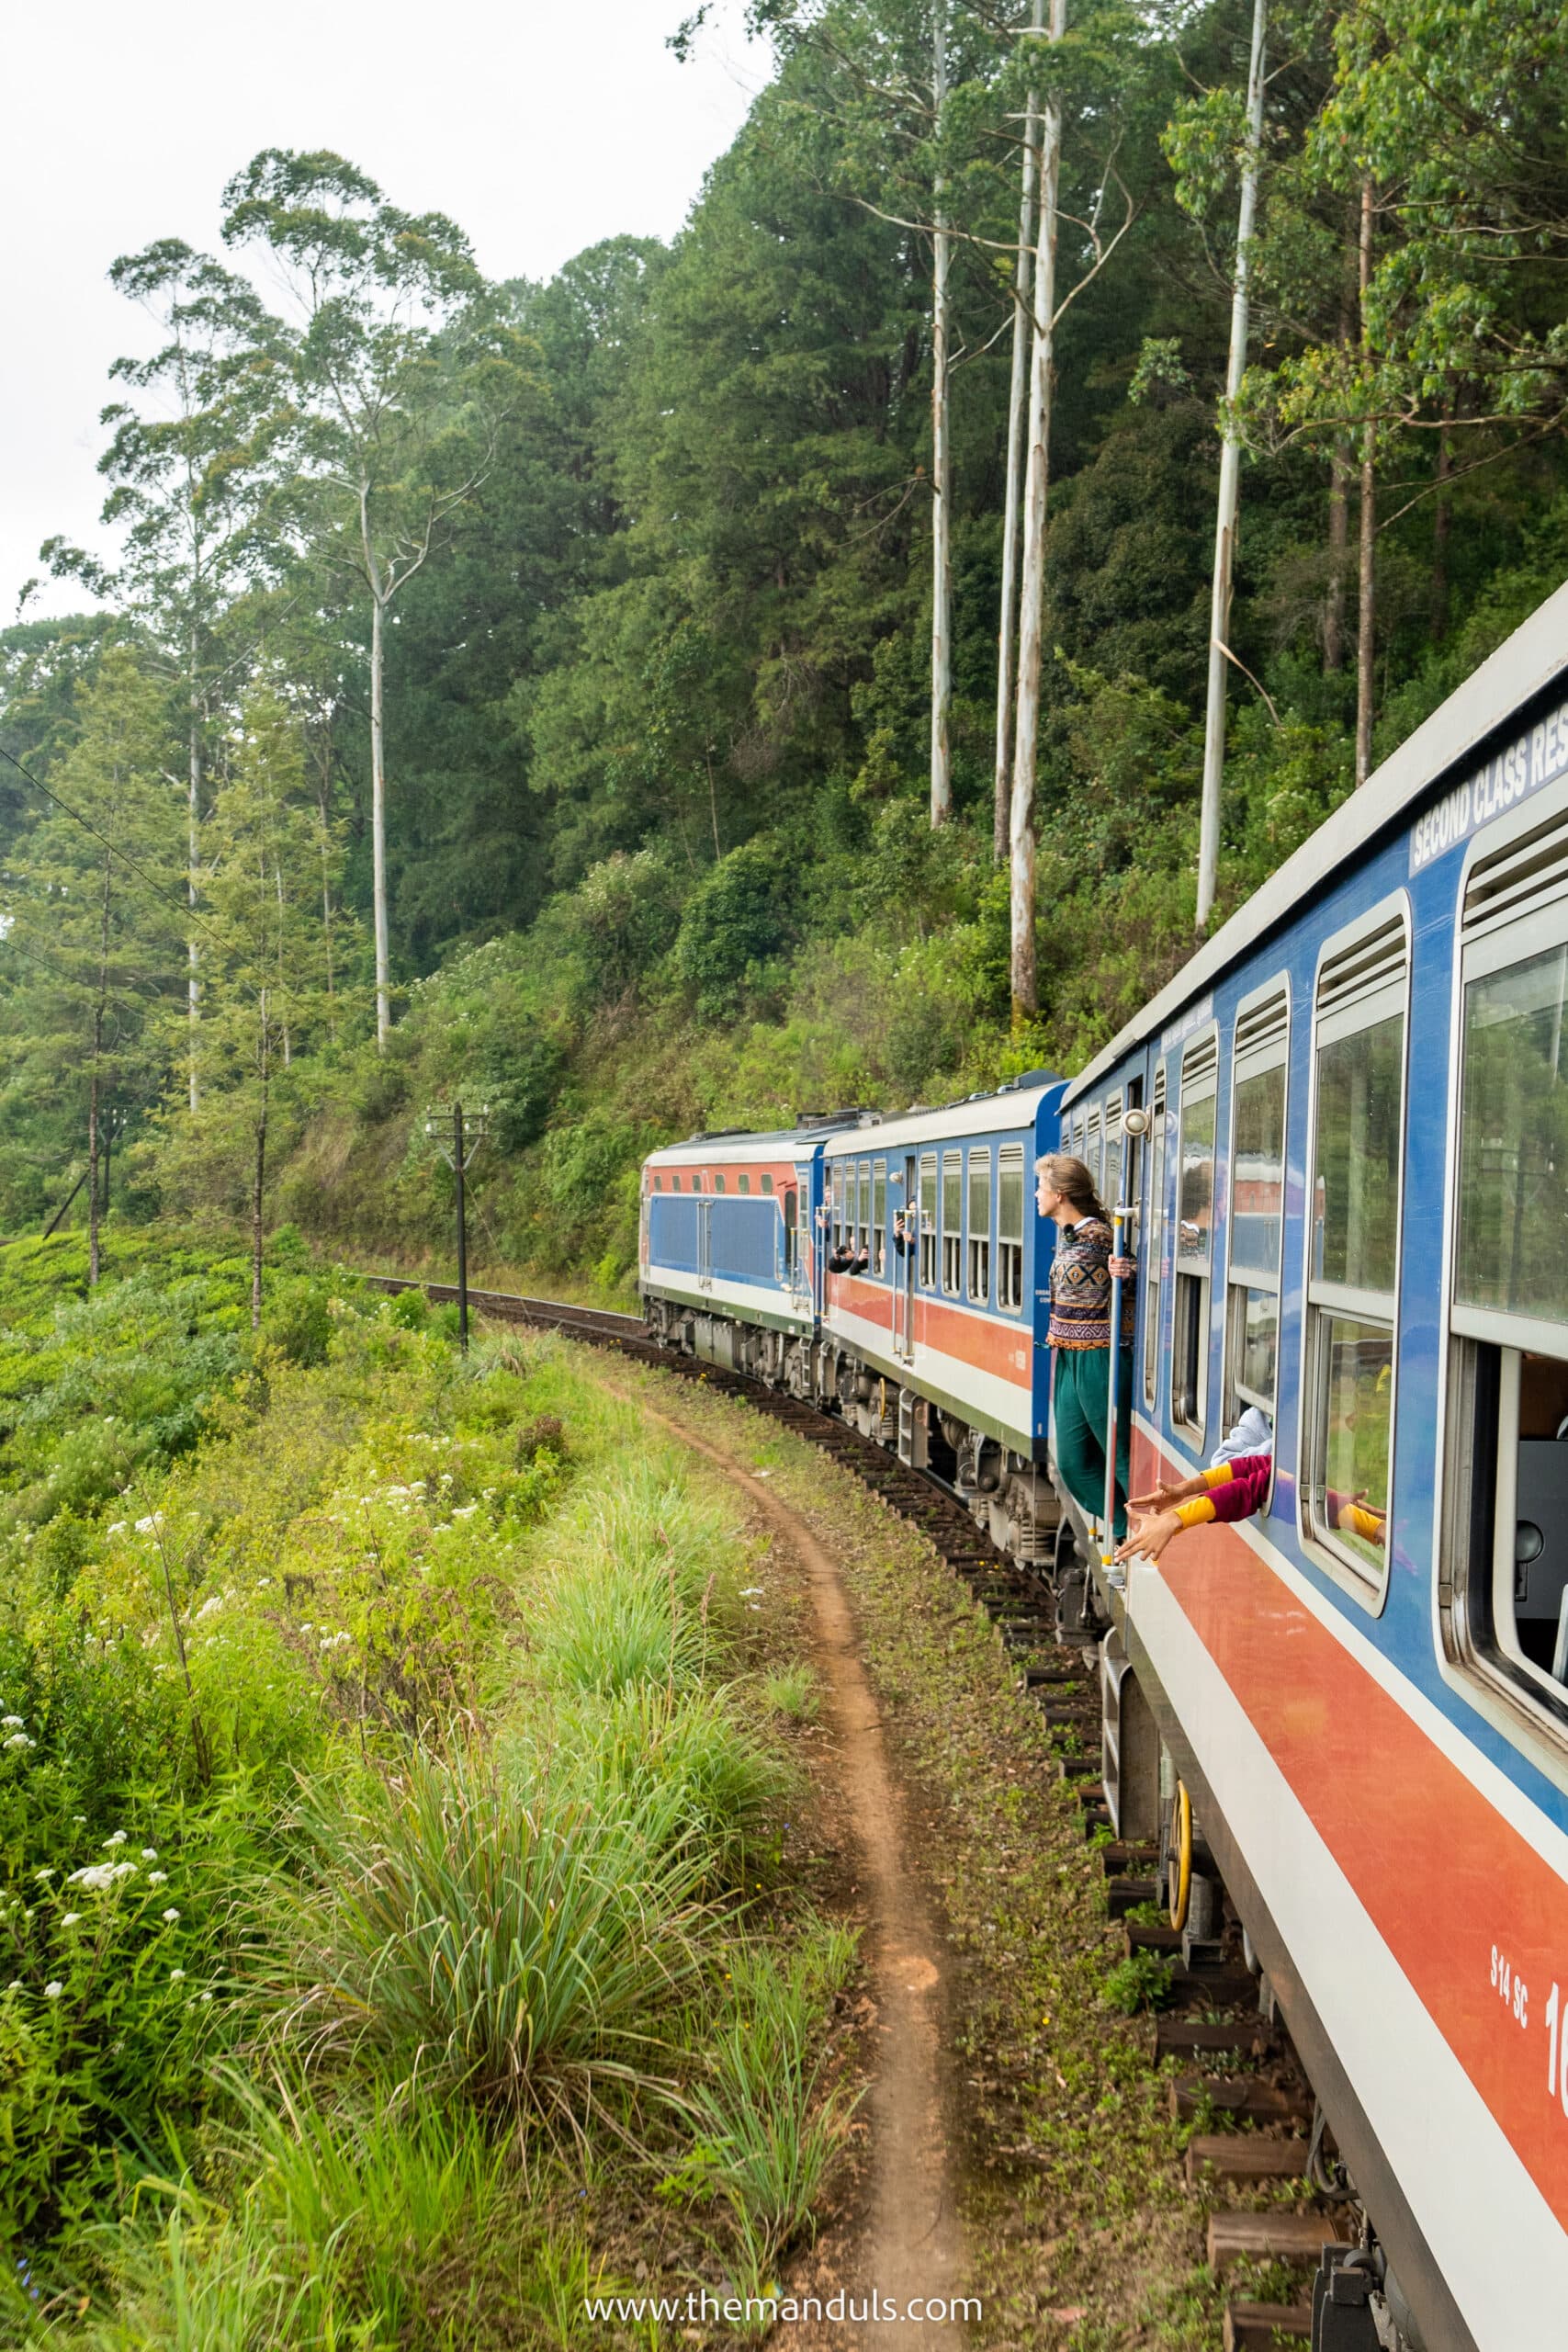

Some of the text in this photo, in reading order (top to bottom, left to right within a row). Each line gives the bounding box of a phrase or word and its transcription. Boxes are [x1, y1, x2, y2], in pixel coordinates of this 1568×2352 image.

[1414, 784, 1470, 866] SECOND
[1473, 738, 1527, 825] CLASS
[1490, 1944, 1510, 2007] S14
[1513, 1974, 1528, 2030] SC
